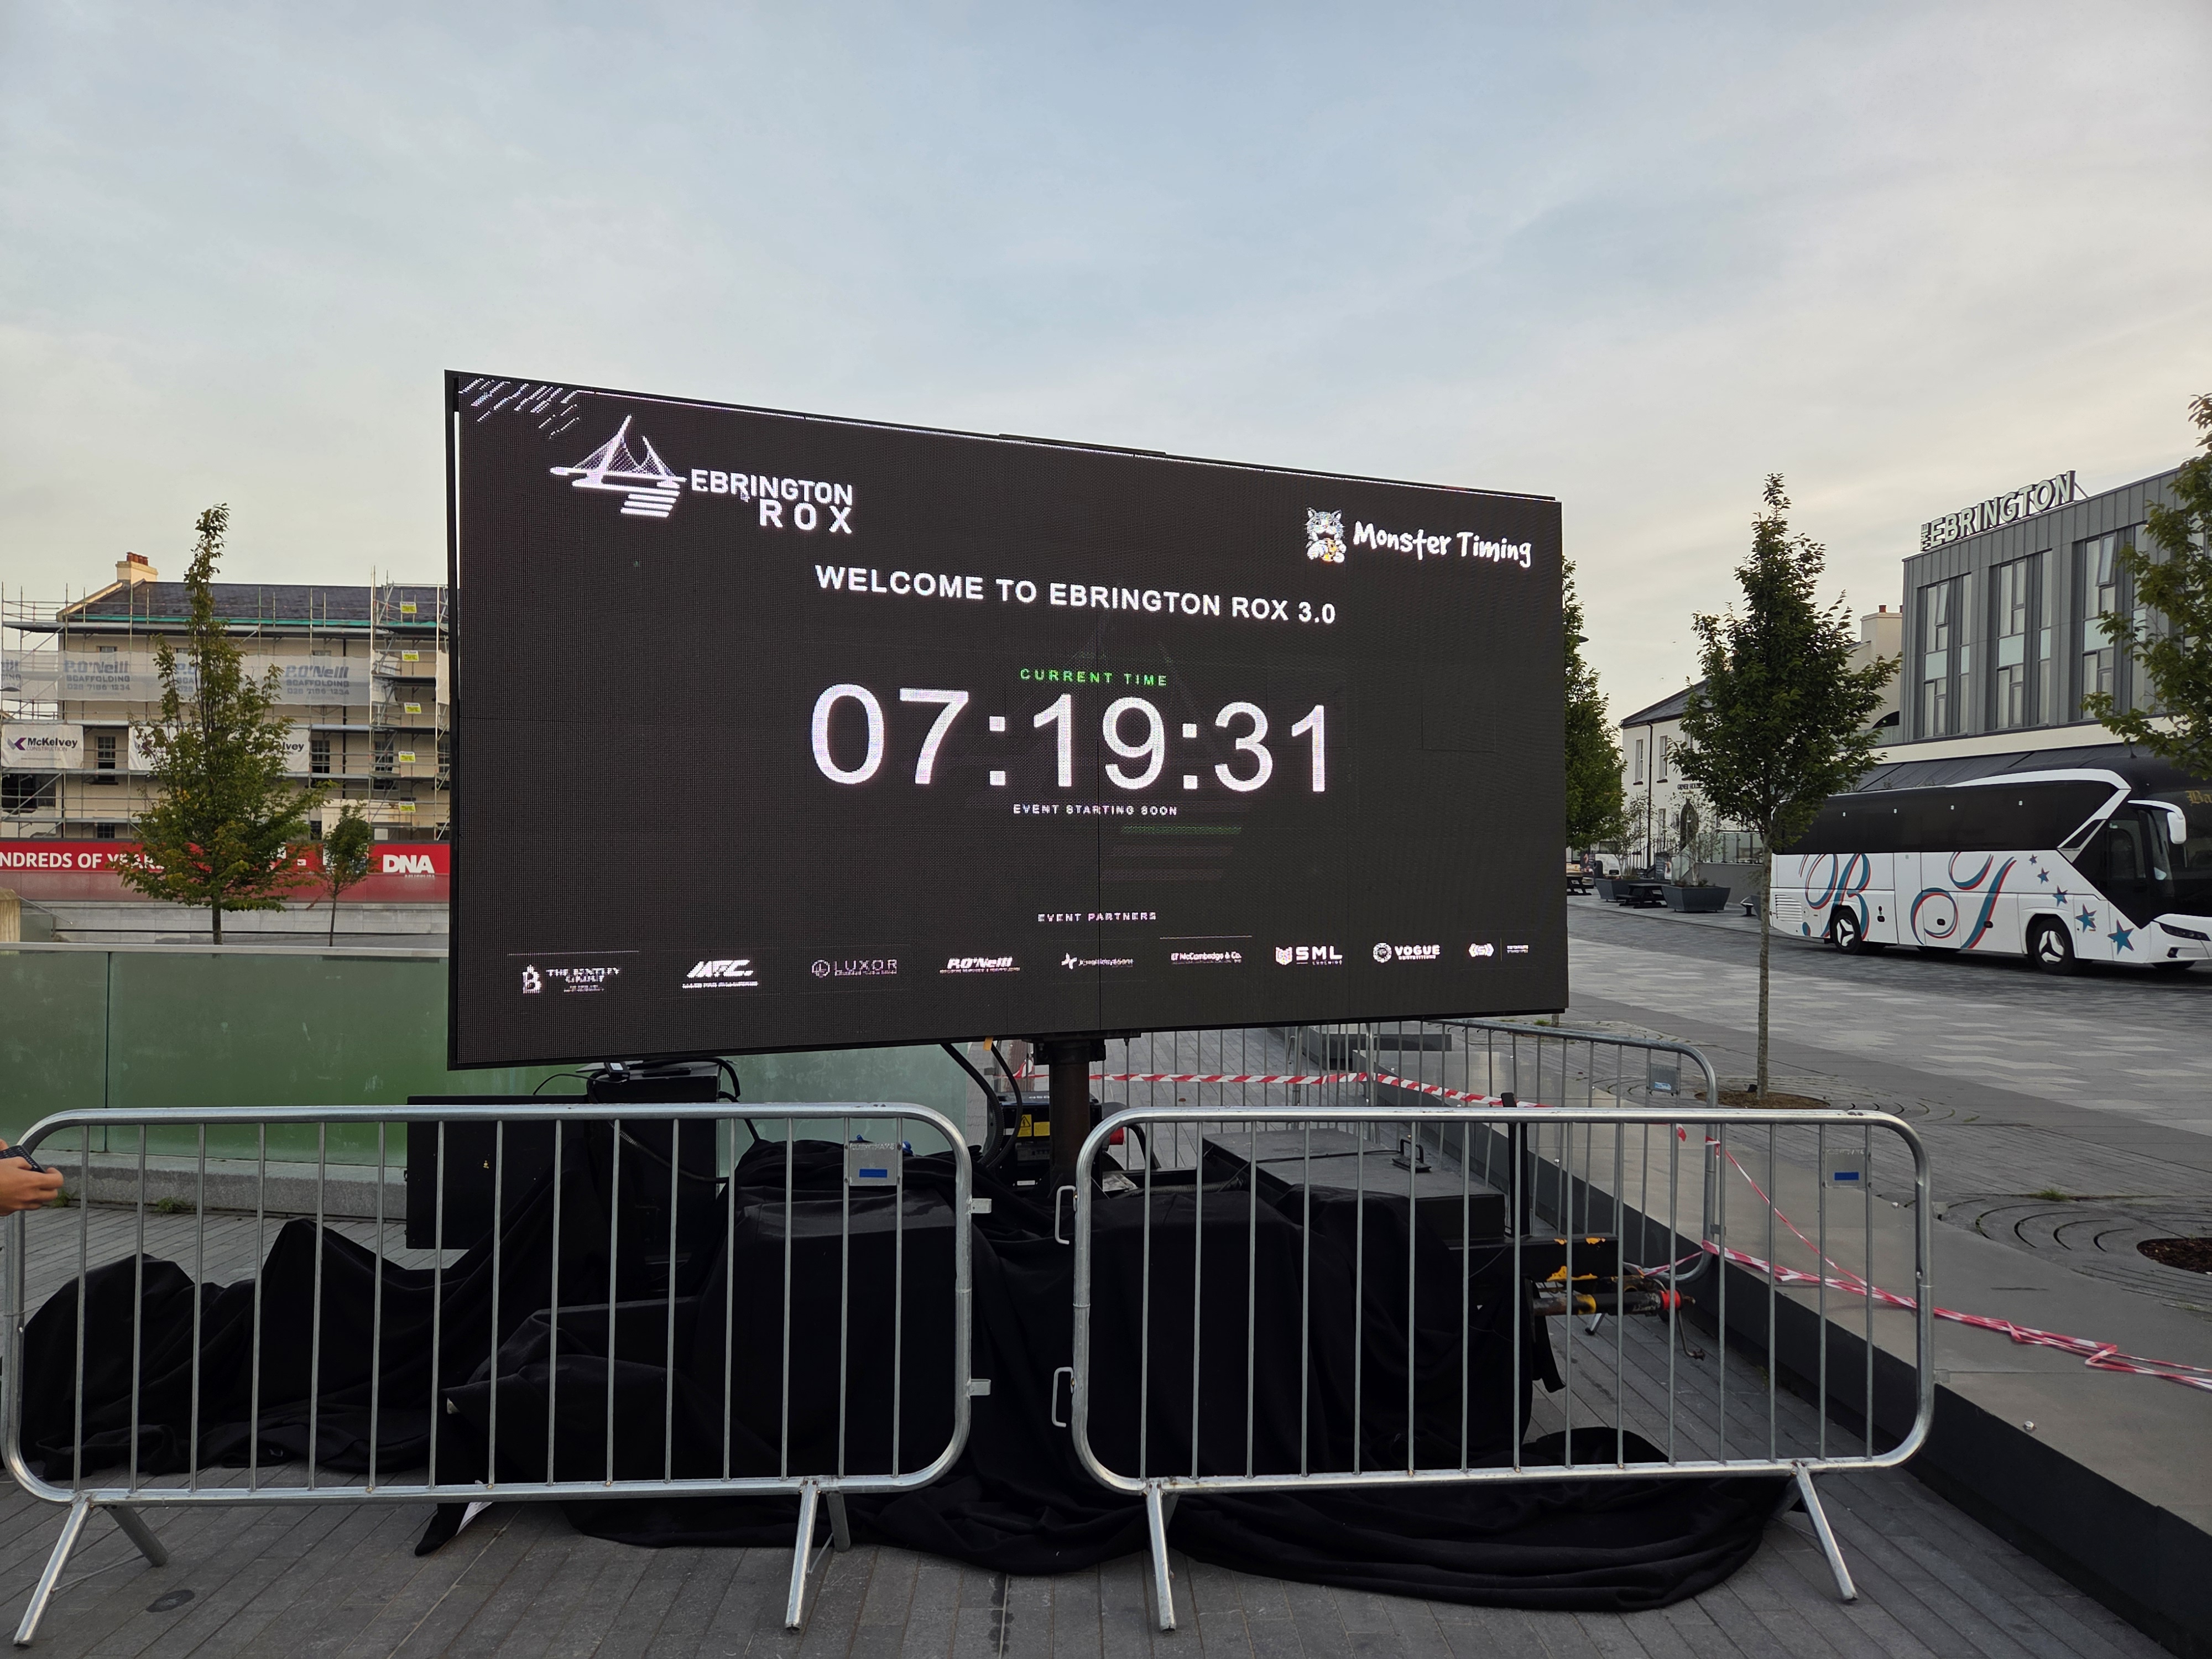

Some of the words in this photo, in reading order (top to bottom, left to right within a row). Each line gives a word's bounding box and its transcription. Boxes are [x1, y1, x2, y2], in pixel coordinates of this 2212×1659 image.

[691, 468, 852, 506] EBRINGTON
[760, 499, 852, 534] ROX
[1931, 471, 2075, 549] EBRINGTON
[1353, 520, 1452, 561] Monster
[1457, 531, 1532, 568] Timing
[815, 565, 984, 600] WELCOME
[995, 578, 1037, 603] TO
[1050, 582, 1220, 616] EBRINGTON
[1232, 597, 1289, 621] ROX
[1299, 601, 1335, 624] 3.0
[66, 674, 131, 682] SCAFFOLDING
[286, 679, 350, 687] SCAFFOLDING
[1020, 668, 1112, 684] CURRENT
[1124, 673, 1167, 686] TIME
[28, 737, 77, 748] McKelvey
[811, 683, 1326, 792] 07:19:31
[1013, 804, 1060, 815] EVENT
[1066, 805, 1135, 816] STARTING
[1141, 806, 1177, 816] SOON
[0, 852, 72, 868] NDREDS
[77, 853, 102, 869] OF
[383, 854, 435, 873] DNA
[1038, 913, 1082, 922] EVENT
[1088, 912, 1156, 921] PARTNERS
[1296, 945, 1343, 961] SML
[1394, 945, 1441, 956] VOGUE
[834, 959, 897, 972] LUXOR
